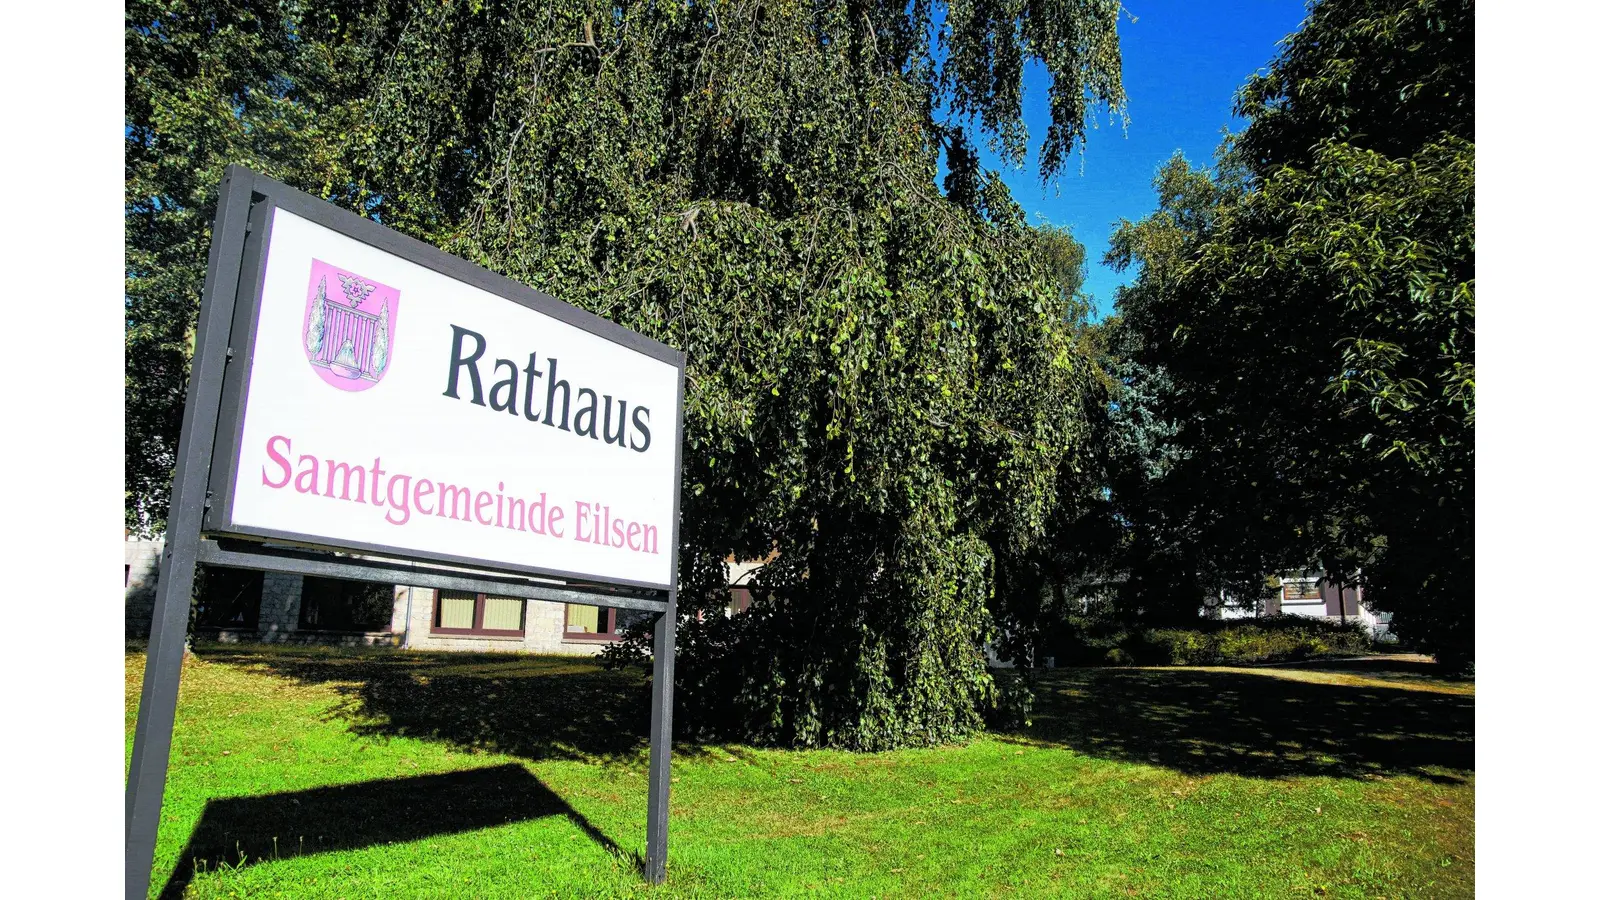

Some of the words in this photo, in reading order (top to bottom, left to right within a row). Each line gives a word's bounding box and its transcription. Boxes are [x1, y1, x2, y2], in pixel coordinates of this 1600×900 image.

[442, 323, 652, 453] Rathaus
[262, 435, 565, 538] Samtgemeinde
[574, 500, 659, 555] Eilsen
